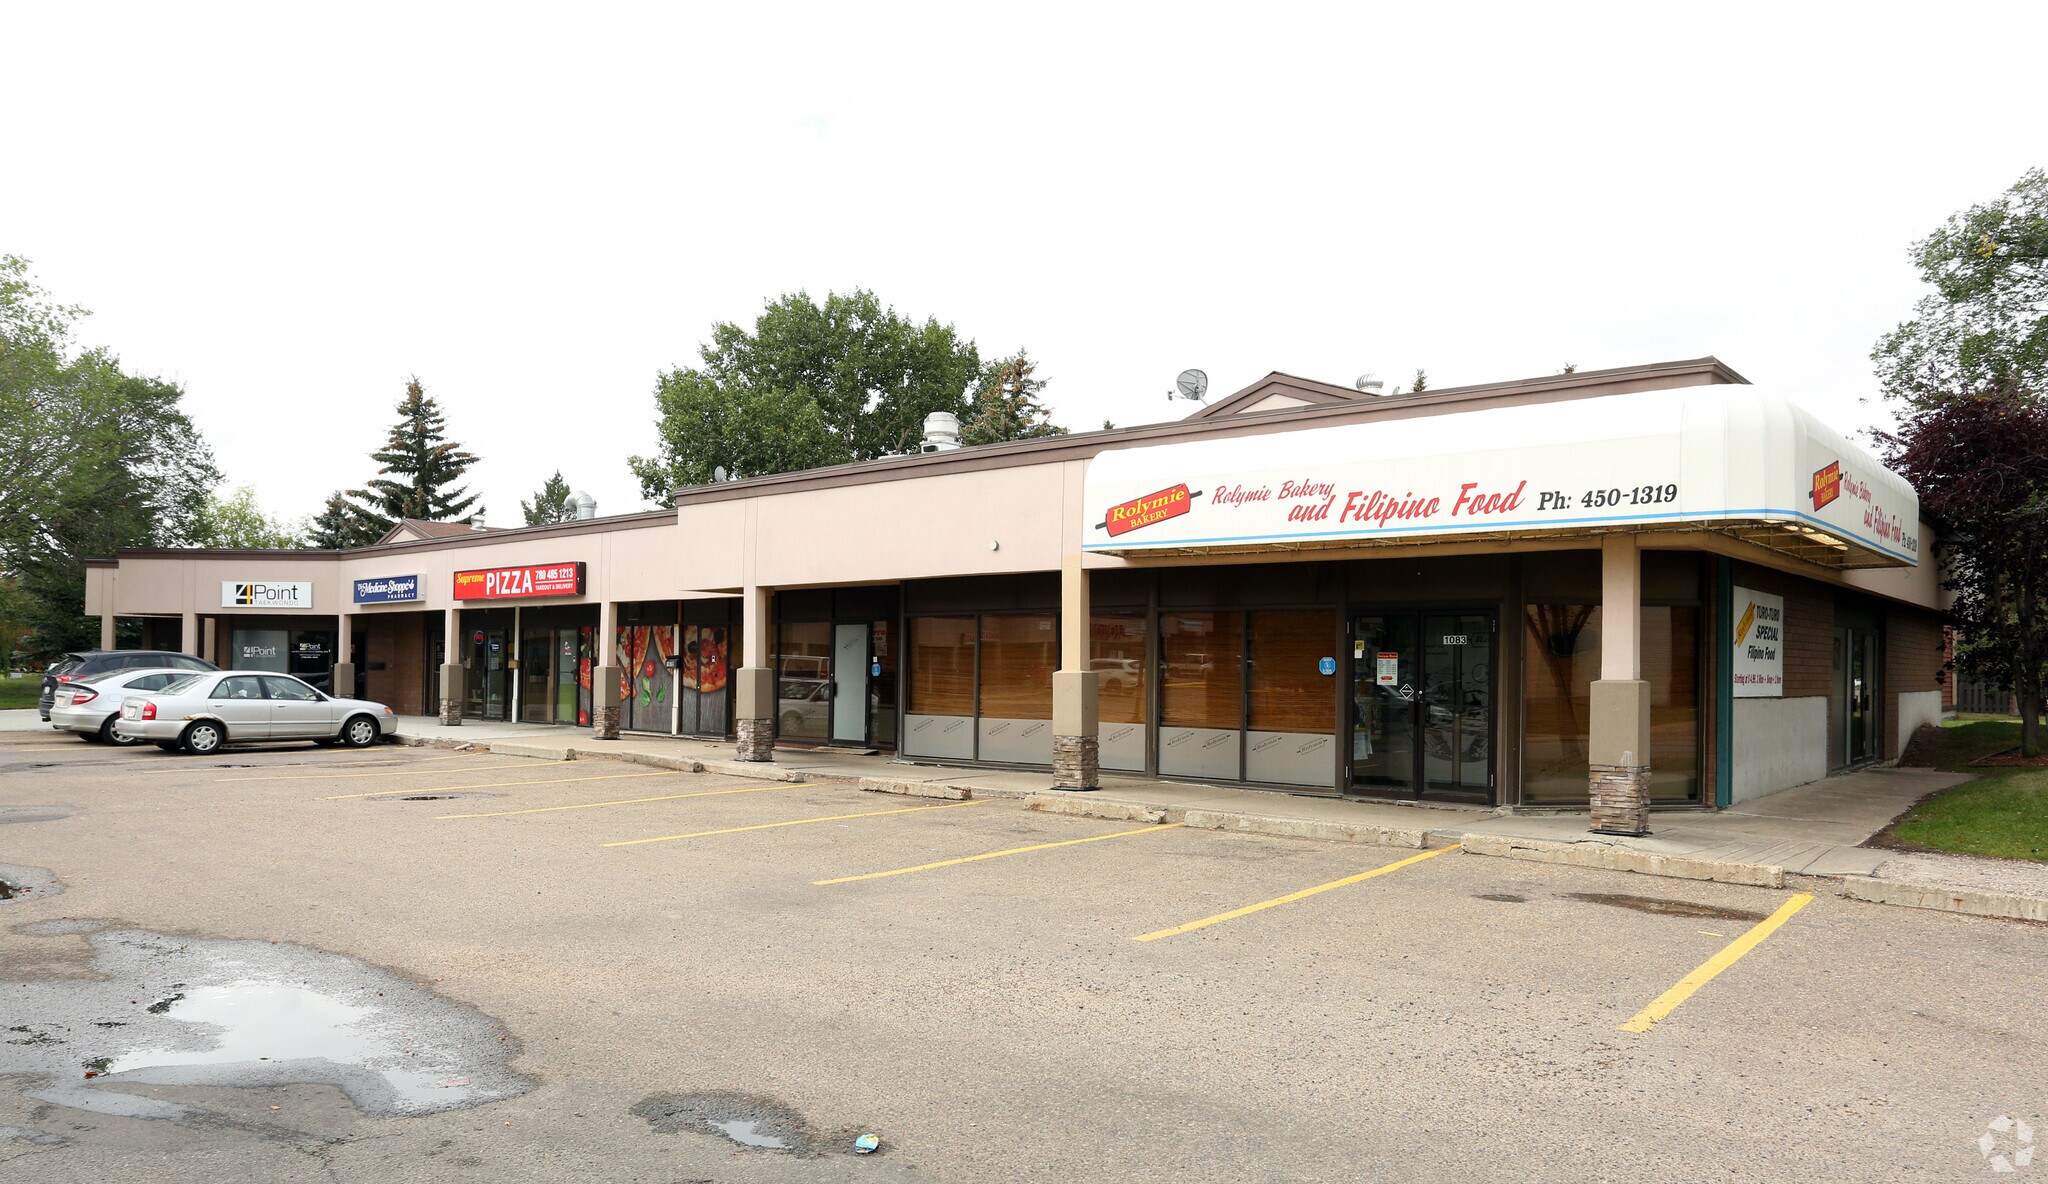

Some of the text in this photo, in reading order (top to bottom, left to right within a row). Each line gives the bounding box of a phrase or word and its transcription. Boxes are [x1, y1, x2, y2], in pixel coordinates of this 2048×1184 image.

[1815, 467, 1838, 491] Rolymie
[1211, 478, 1335, 508] Rolymie Bakery
[1111, 489, 1185, 523] Rolymie
[1287, 480, 1679, 528] and Filipino Food Ph: 450-1319
[1129, 508, 1168, 528] BAKERY
[456, 573, 485, 586] Supreme
[535, 570, 547, 580] 780
[559, 567, 574, 578] 1213
[360, 581, 389, 597] Medicine
[486, 569, 533, 596] PIZZA
[1756, 605, 1779, 621] TURO-TURO
[1444, 636, 1467, 644] 1083
[1756, 625, 1778, 641] SPECIAL
[1747, 645, 1775, 662] Filipino Food
